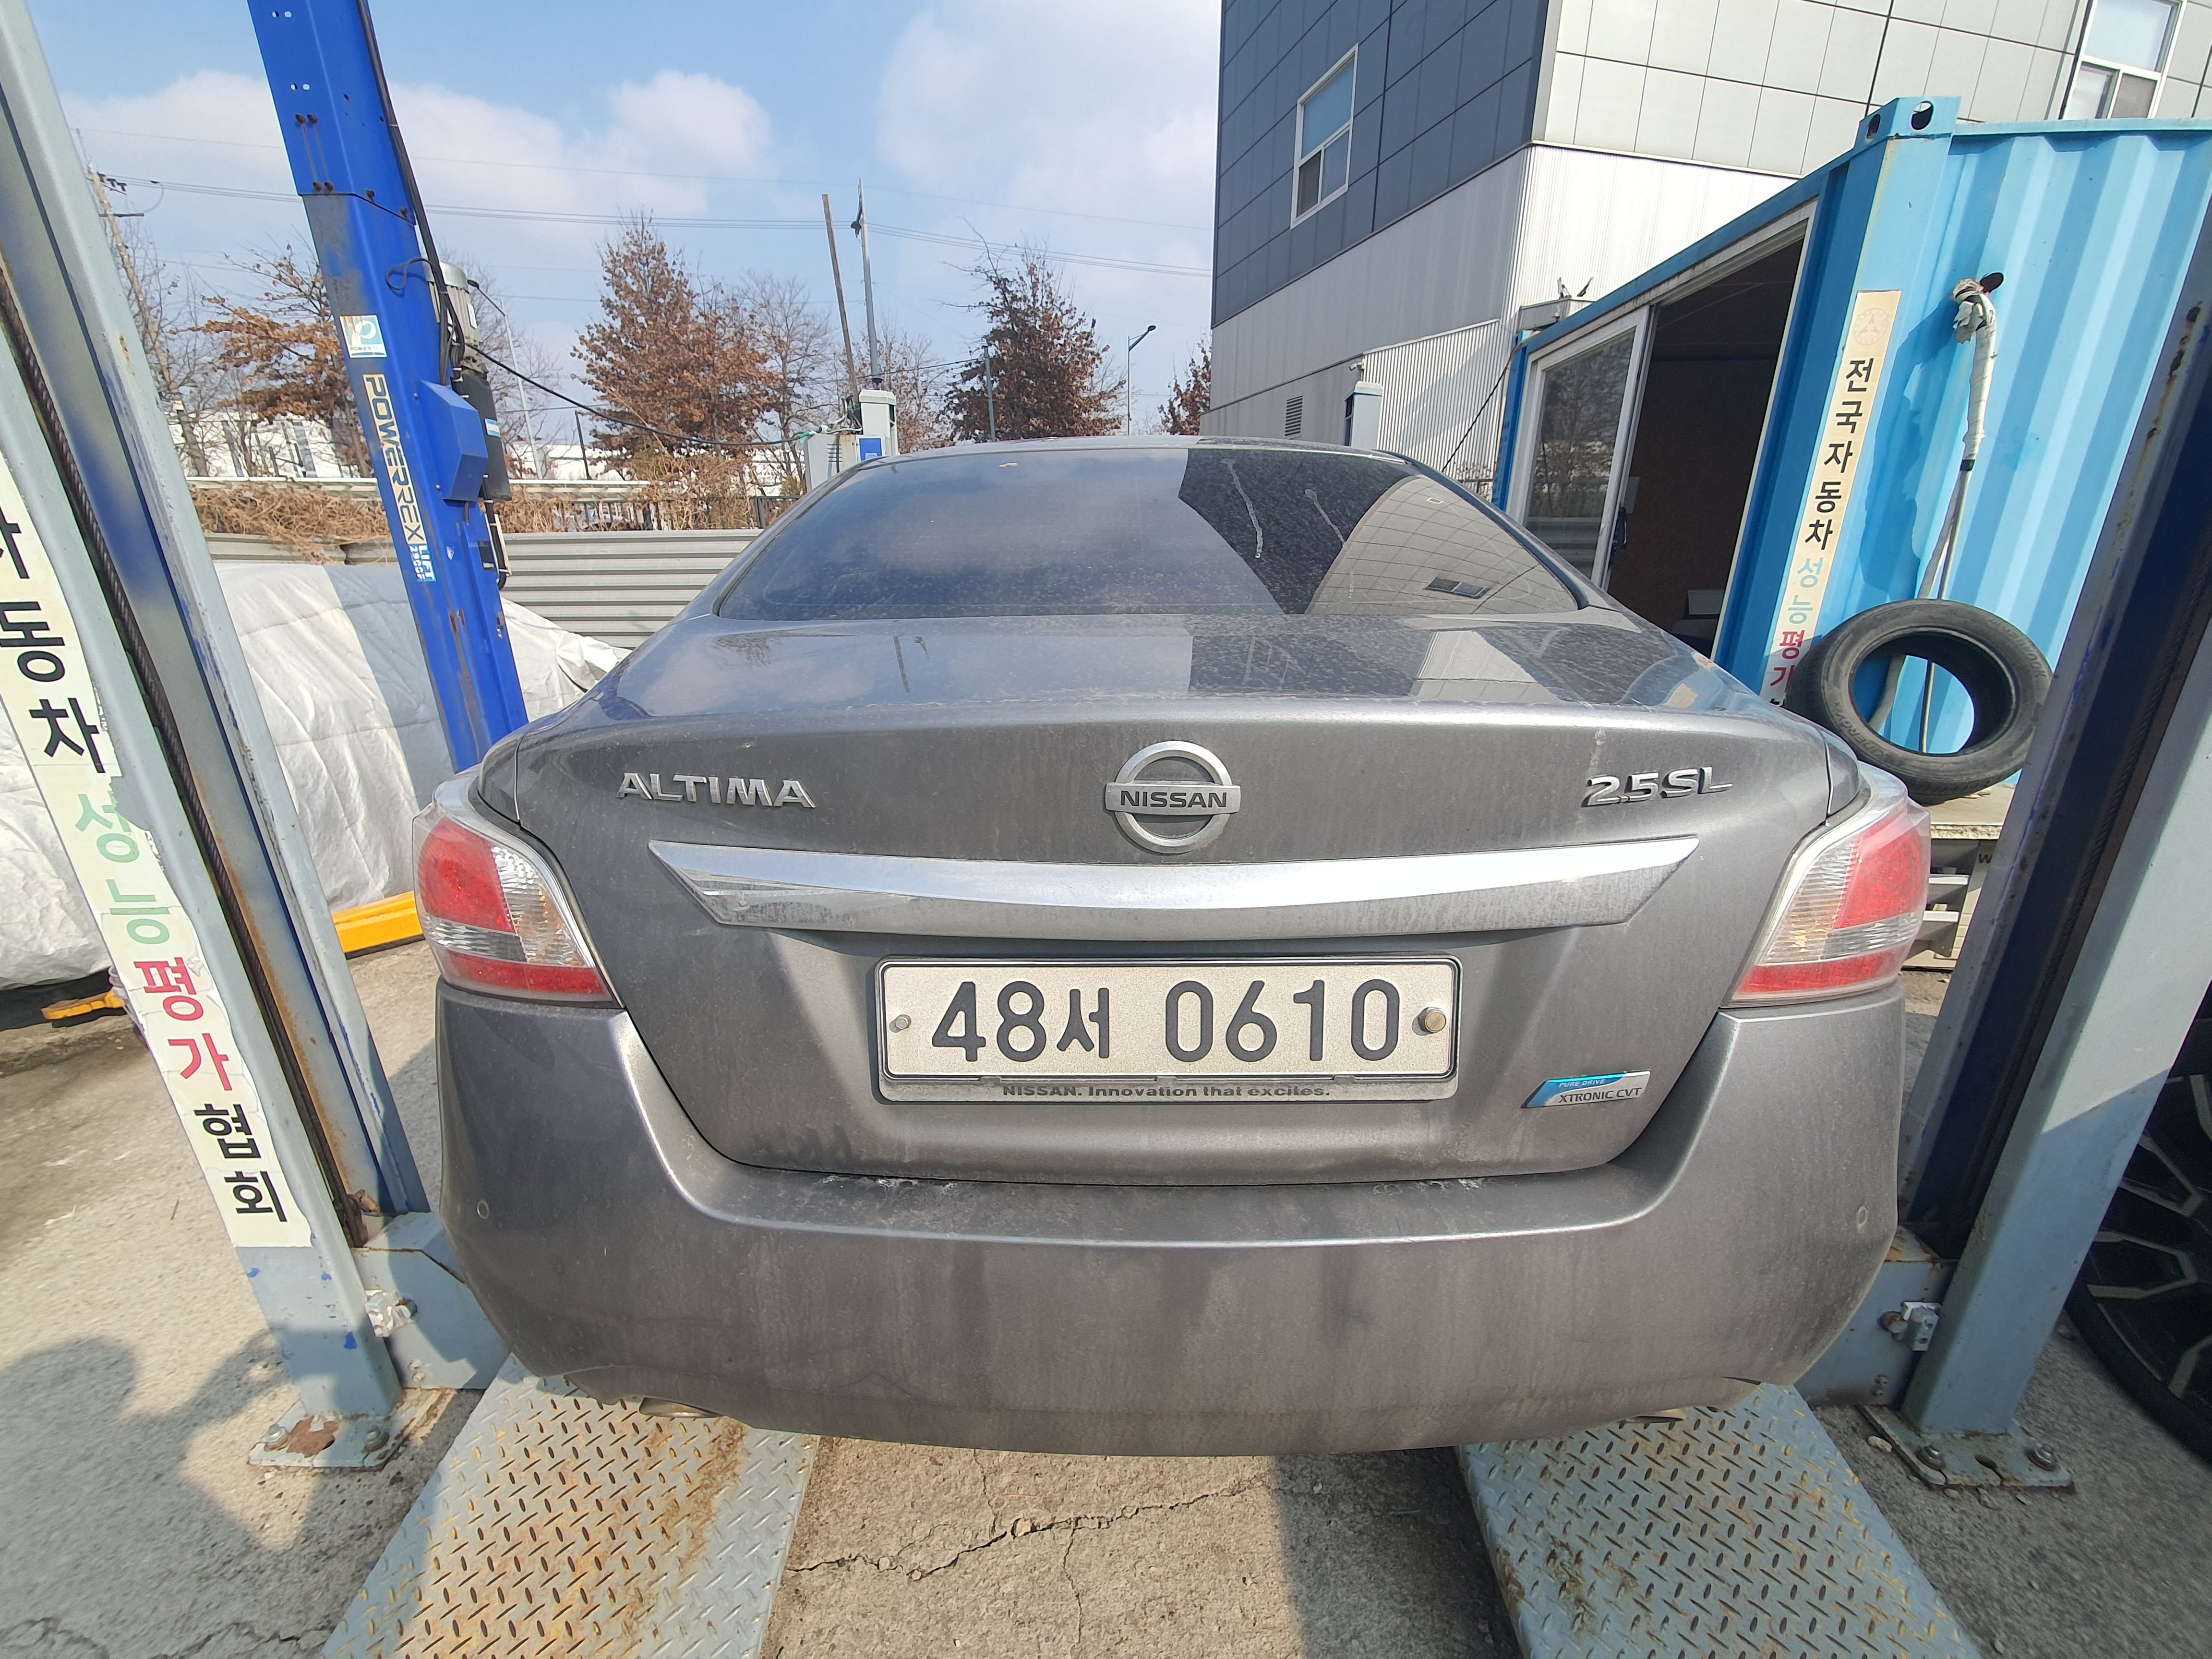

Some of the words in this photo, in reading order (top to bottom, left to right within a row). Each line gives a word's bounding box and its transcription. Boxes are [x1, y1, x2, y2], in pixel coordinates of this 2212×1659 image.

[366, 376, 424, 541] POWERREX
[418, 544, 435, 580] LIFT
[616, 772, 816, 808] ALTIMA
[1120, 790, 1227, 808] NISSAN
[931, 980, 1110, 1062] 48서
[1165, 978, 1400, 1062] 0610
[1003, 1085, 1082, 1096] NISSAN.
[1088, 1086, 1197, 1097] Innovation
[1202, 1085, 1242, 1096] that
[1248, 1085, 1330, 1096] excites.
[1558, 1090, 1614, 1103] XTRONIC
[1616, 1087, 1642, 1098] CVT
